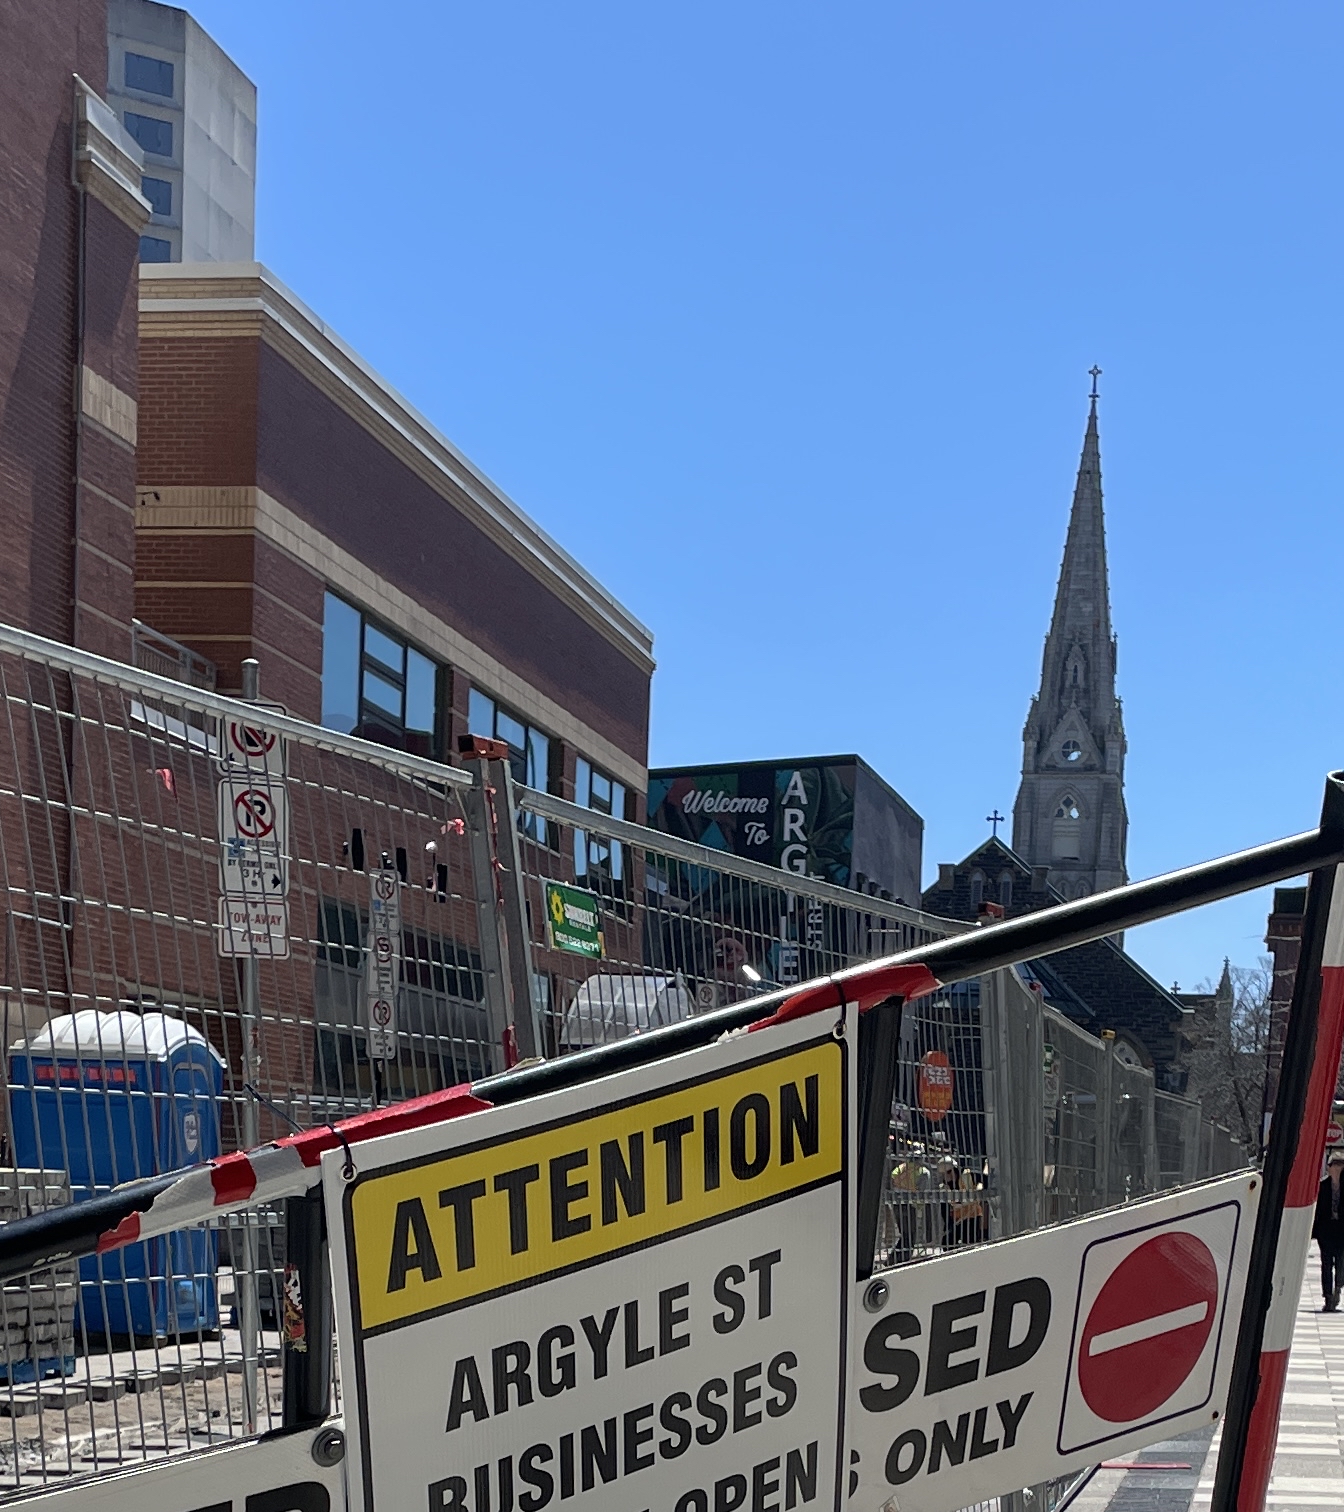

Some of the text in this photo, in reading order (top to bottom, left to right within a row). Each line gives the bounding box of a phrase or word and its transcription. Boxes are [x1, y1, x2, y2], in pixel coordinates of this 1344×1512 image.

[682, 789, 770, 814] Welcome
[744, 821, 770, 846] To
[386, 1073, 821, 1294] ATTENTION
[445, 1249, 782, 1433] ARGYLE ST
[885, 1391, 1034, 1485] ONLY
